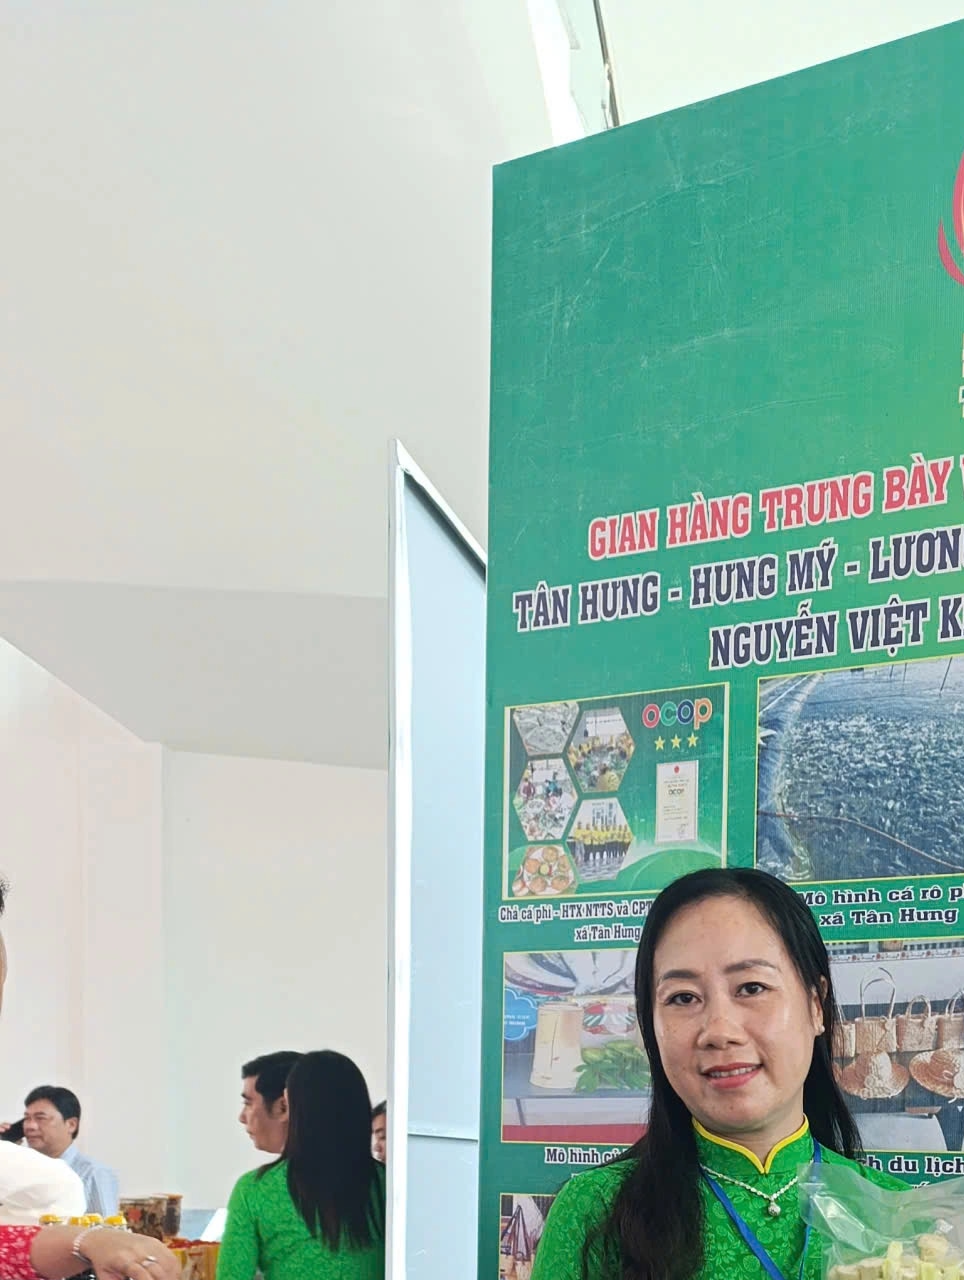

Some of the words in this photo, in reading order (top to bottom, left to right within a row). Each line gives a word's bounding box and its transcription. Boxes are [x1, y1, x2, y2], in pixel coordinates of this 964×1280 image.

[589, 508, 659, 560] GIAN
[666, 492, 752, 547] HÀNG
[760, 472, 873, 531] TRƯNG
[883, 454, 952, 512] BÀY
[513, 582, 571, 631] TÂN
[691, 555, 777, 607] HƯNG
[787, 539, 837, 593] MỸ
[710, 600, 838, 669] NGUYỄN
[847, 596, 929, 656] VIỆT
[799, 891, 827, 906] Mô
[833, 888, 881, 904] hình
[888, 886, 914, 901] cá
[921, 886, 942, 900] rô
[561, 902, 584, 919] HTX
[585, 900, 615, 918] NTTS
[616, 901, 629, 916] và
[819, 912, 844, 926] xã
[851, 910, 893, 925] Tân
[545, 1147, 566, 1163] Mô
[569, 1148, 600, 1164] hình
[889, 1155, 919, 1172] du
